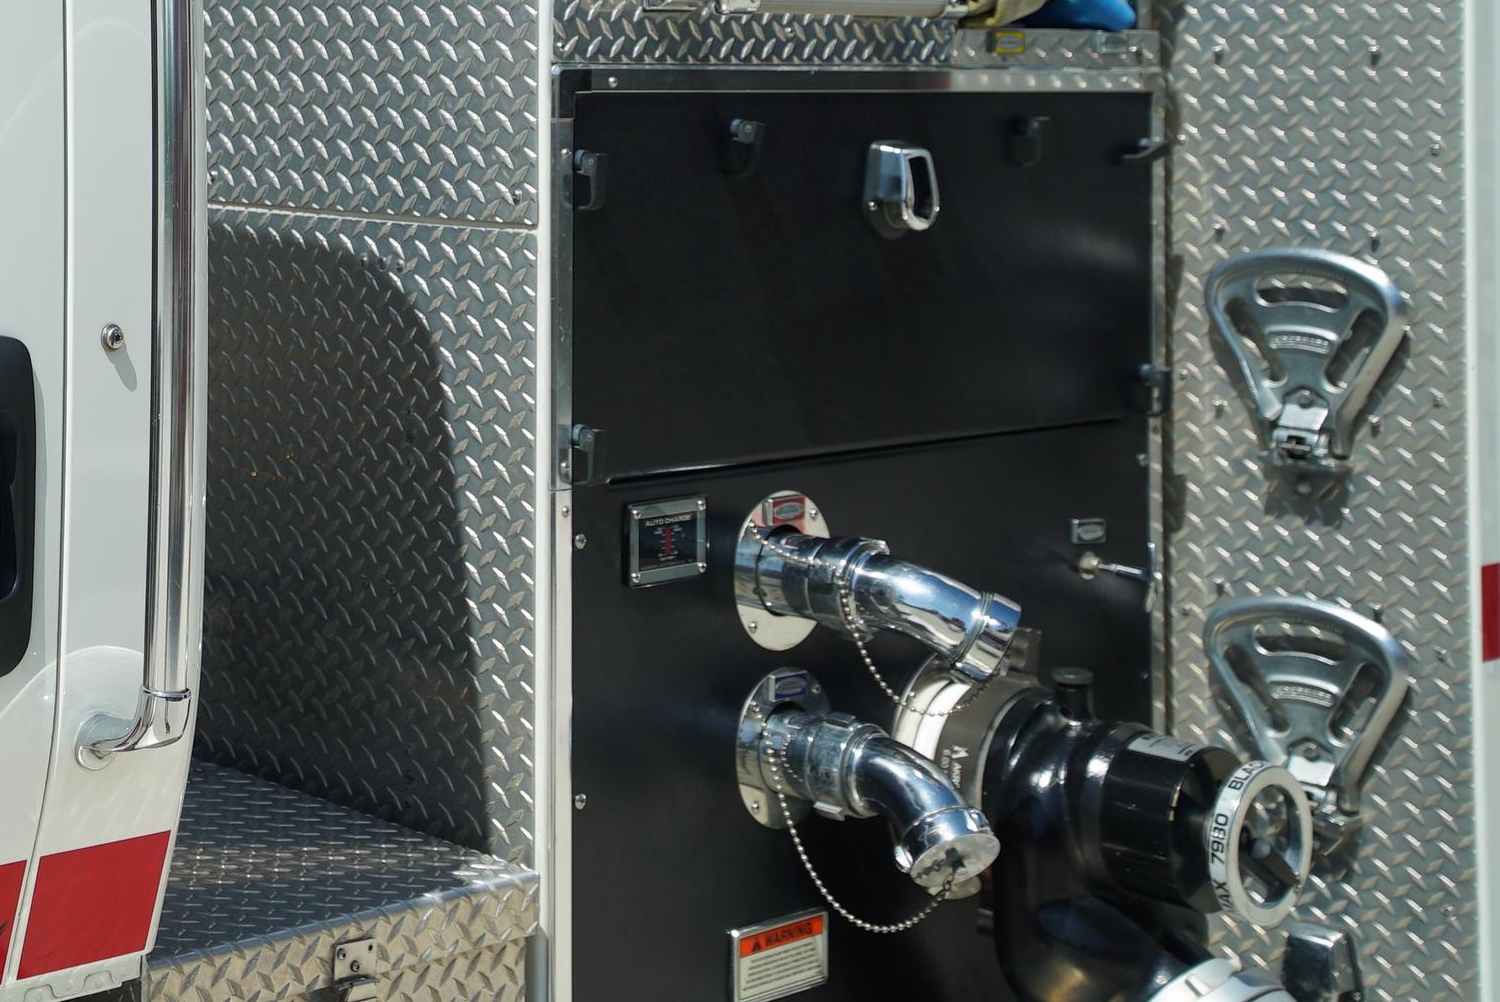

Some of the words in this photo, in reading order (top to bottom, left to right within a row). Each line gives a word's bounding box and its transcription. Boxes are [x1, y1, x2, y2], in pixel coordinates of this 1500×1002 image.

[645, 518, 664, 527] AUTO
[1211, 812, 1229, 865] 7980
[1228, 760, 1265, 791] BLAC
[764, 921, 813, 947] WARNING
